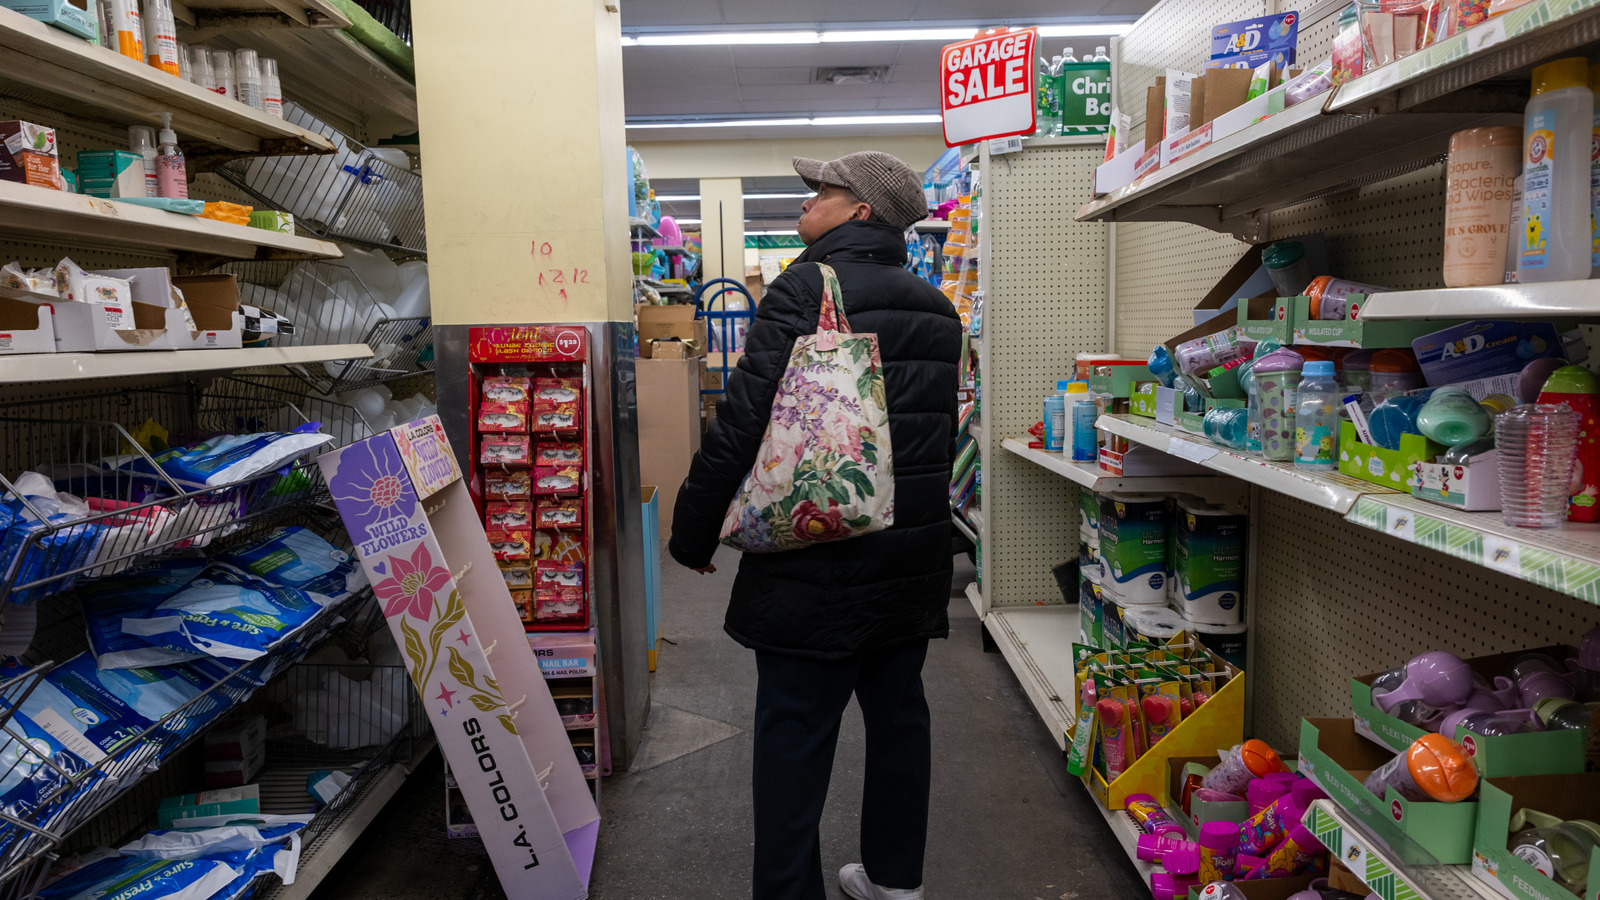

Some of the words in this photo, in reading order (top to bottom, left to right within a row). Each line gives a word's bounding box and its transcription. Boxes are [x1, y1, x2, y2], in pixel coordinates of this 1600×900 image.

[947, 34, 1029, 73] GARAGE
[1224, 29, 1261, 55] A&D
[948, 57, 1024, 106] SALE
[1465, 189, 1512, 203] Wipes
[1467, 223, 1508, 235] GROVE
[572, 267, 591, 284] 12
[1308, 327, 1332, 336] INSULATED
[1332, 328, 1344, 336] CUP
[1440, 334, 1485, 361] A&D
[1485, 335, 1517, 349] Cream
[415, 424, 434, 438] COLORS
[417, 439, 439, 462] WILD
[419, 455, 453, 487] FLOWERS
[368, 516, 408, 539] WILD
[361, 522, 428, 557] FLOWERS
[231, 621, 264, 635] Sure
[542, 660, 562, 668] NAIL
[562, 659, 580, 667] BAR
[70, 669, 102, 692] DISPOSABLE
[102, 691, 126, 708] JETABLE
[114, 730, 127, 739] 2
[1382, 724, 1400, 741] FLEXI
[462, 717, 519, 822] COLORS
[1324, 772, 1340, 791] FLEXI
[1340, 785, 1361, 808] STRAW
[1358, 802, 1373, 817] CUP
[1264, 804, 1277, 830] Trolls
[513, 824, 540, 871] L.A.
[163, 860, 194, 878] Sure
[1212, 856, 1235, 867] Trolls
[111, 880, 154, 900] Fresh
